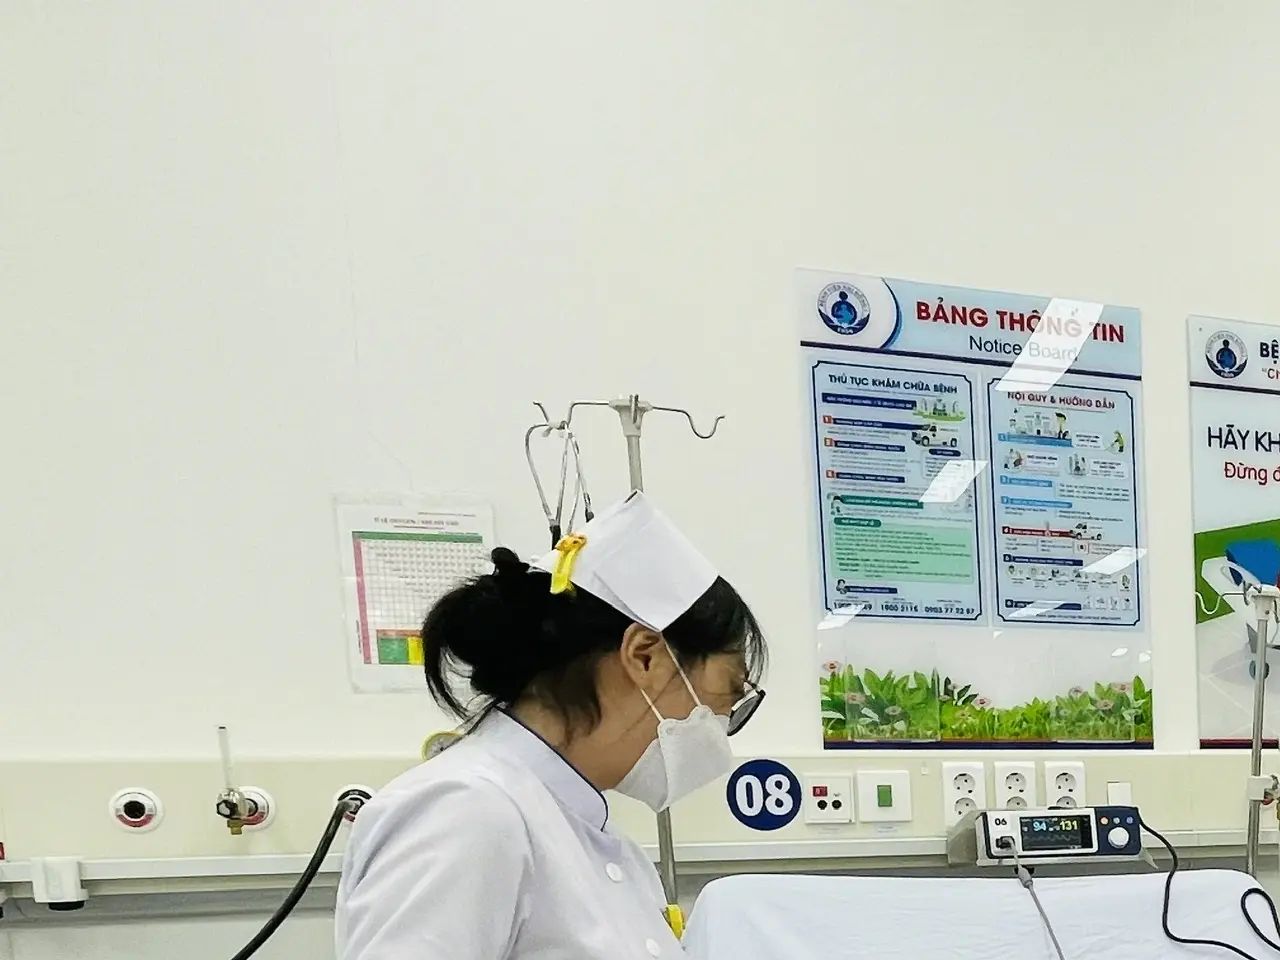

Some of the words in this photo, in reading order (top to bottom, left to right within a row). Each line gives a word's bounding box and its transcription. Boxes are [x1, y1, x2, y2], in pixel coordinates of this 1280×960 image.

[916, 296, 989, 328] BẢNG
[996, 309, 1082, 338] THÔNG
[1089, 322, 1125, 343] TIN
[969, 335, 1023, 356] Notice
[1029, 341, 1078, 362] Board
[828, 373, 847, 384] THỦ
[849, 376, 869, 387] TỤC
[872, 377, 901, 389] KHÁM
[903, 380, 931, 392] CHỮA
[933, 382, 958, 394] BỆNH
[1028, 393, 1047, 403] QUY
[1050, 395, 1056, 404] &
[1059, 395, 1093, 408] HƯỚNG
[1095, 396, 1115, 409] DẪN
[1207, 424, 1250, 450] HÃY
[1224, 461, 1268, 486] Đừng
[735, 774, 794, 817] 08
[994, 817, 1008, 826] 06
[1032, 821, 1047, 832] 94
[1059, 820, 1079, 831] 131
